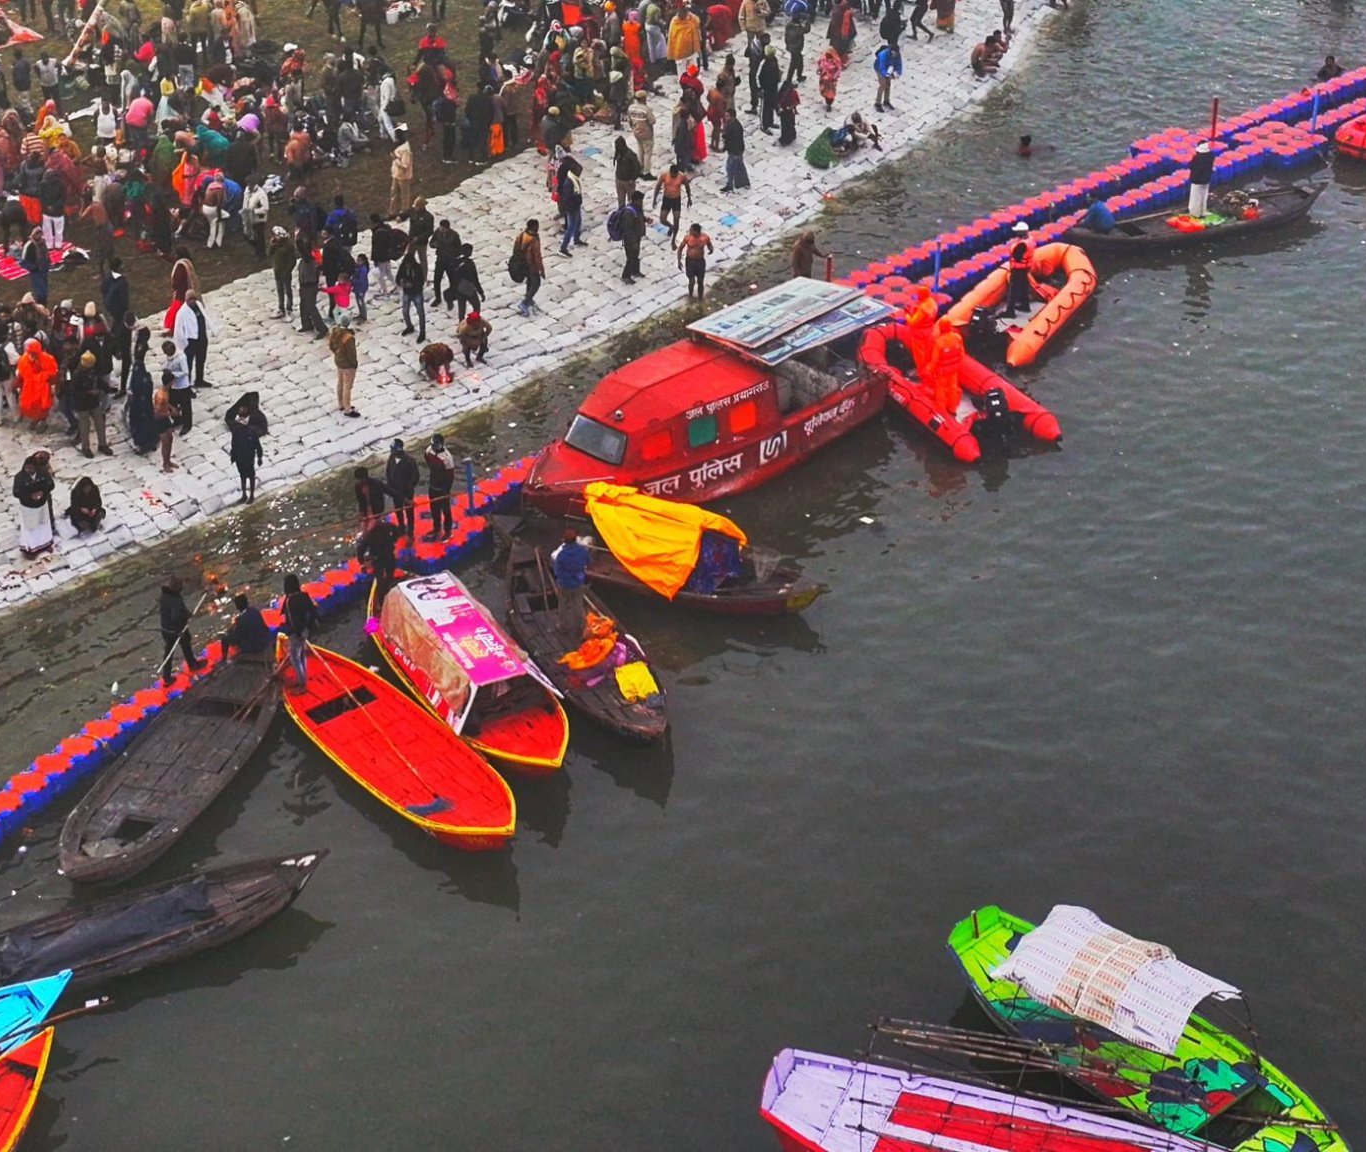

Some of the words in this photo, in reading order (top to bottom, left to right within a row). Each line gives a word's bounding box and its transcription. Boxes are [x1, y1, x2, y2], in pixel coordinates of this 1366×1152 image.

[685, 406, 704, 420] जल
[733, 380, 770, 403] प्रयागराज
[641, 474, 681, 496] जल
